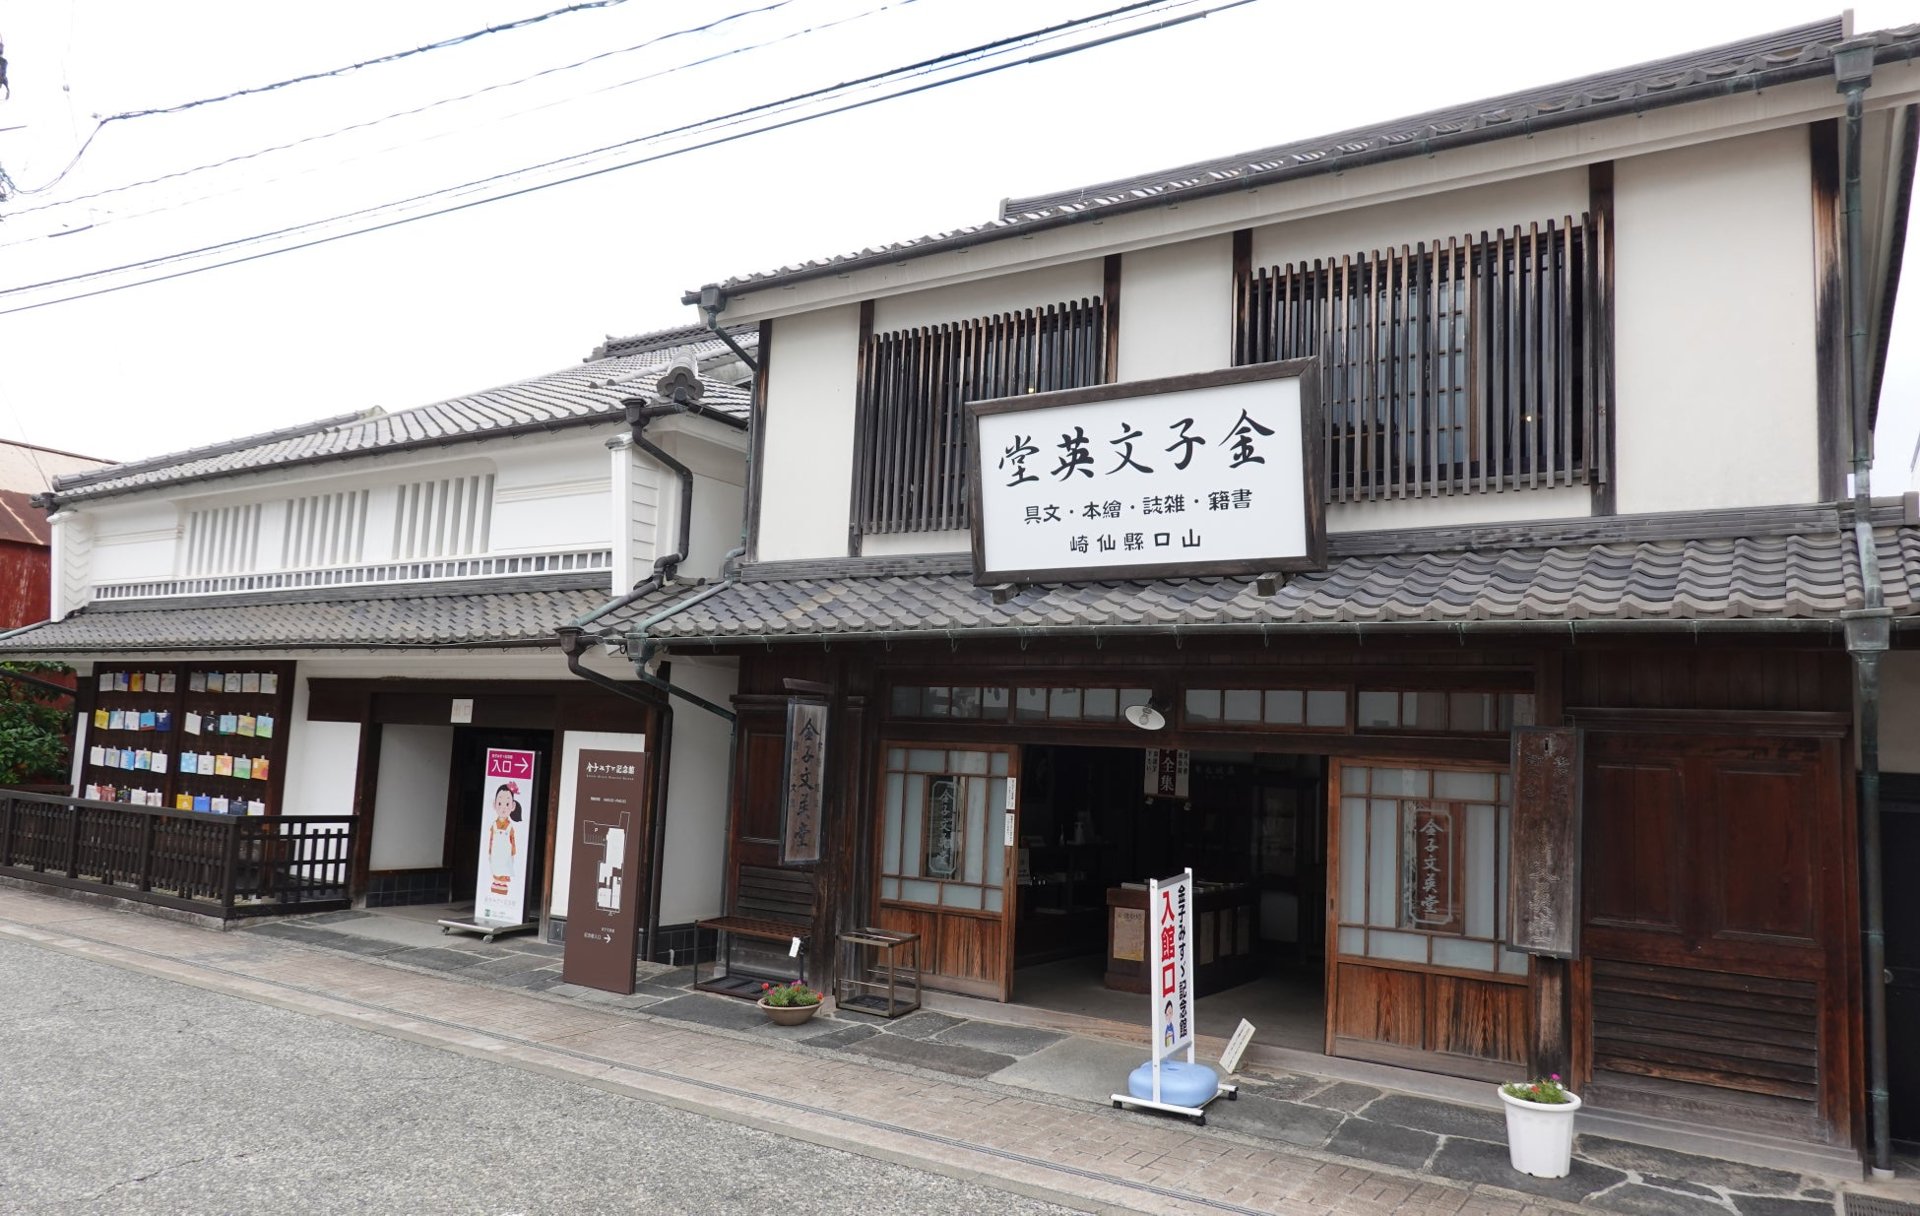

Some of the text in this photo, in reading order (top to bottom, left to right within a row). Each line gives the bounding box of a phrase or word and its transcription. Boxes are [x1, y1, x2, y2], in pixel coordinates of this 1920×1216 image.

[998, 408, 1275, 487] 金子文英堂
[1070, 529, 1202, 554] 山口縣仙崎
[491, 759, 511, 773] 入口
[794, 718, 820, 848] 金子文英堂
[1419, 818, 1444, 914] 金子文英堂
[1161, 890, 1176, 999] 入館口
